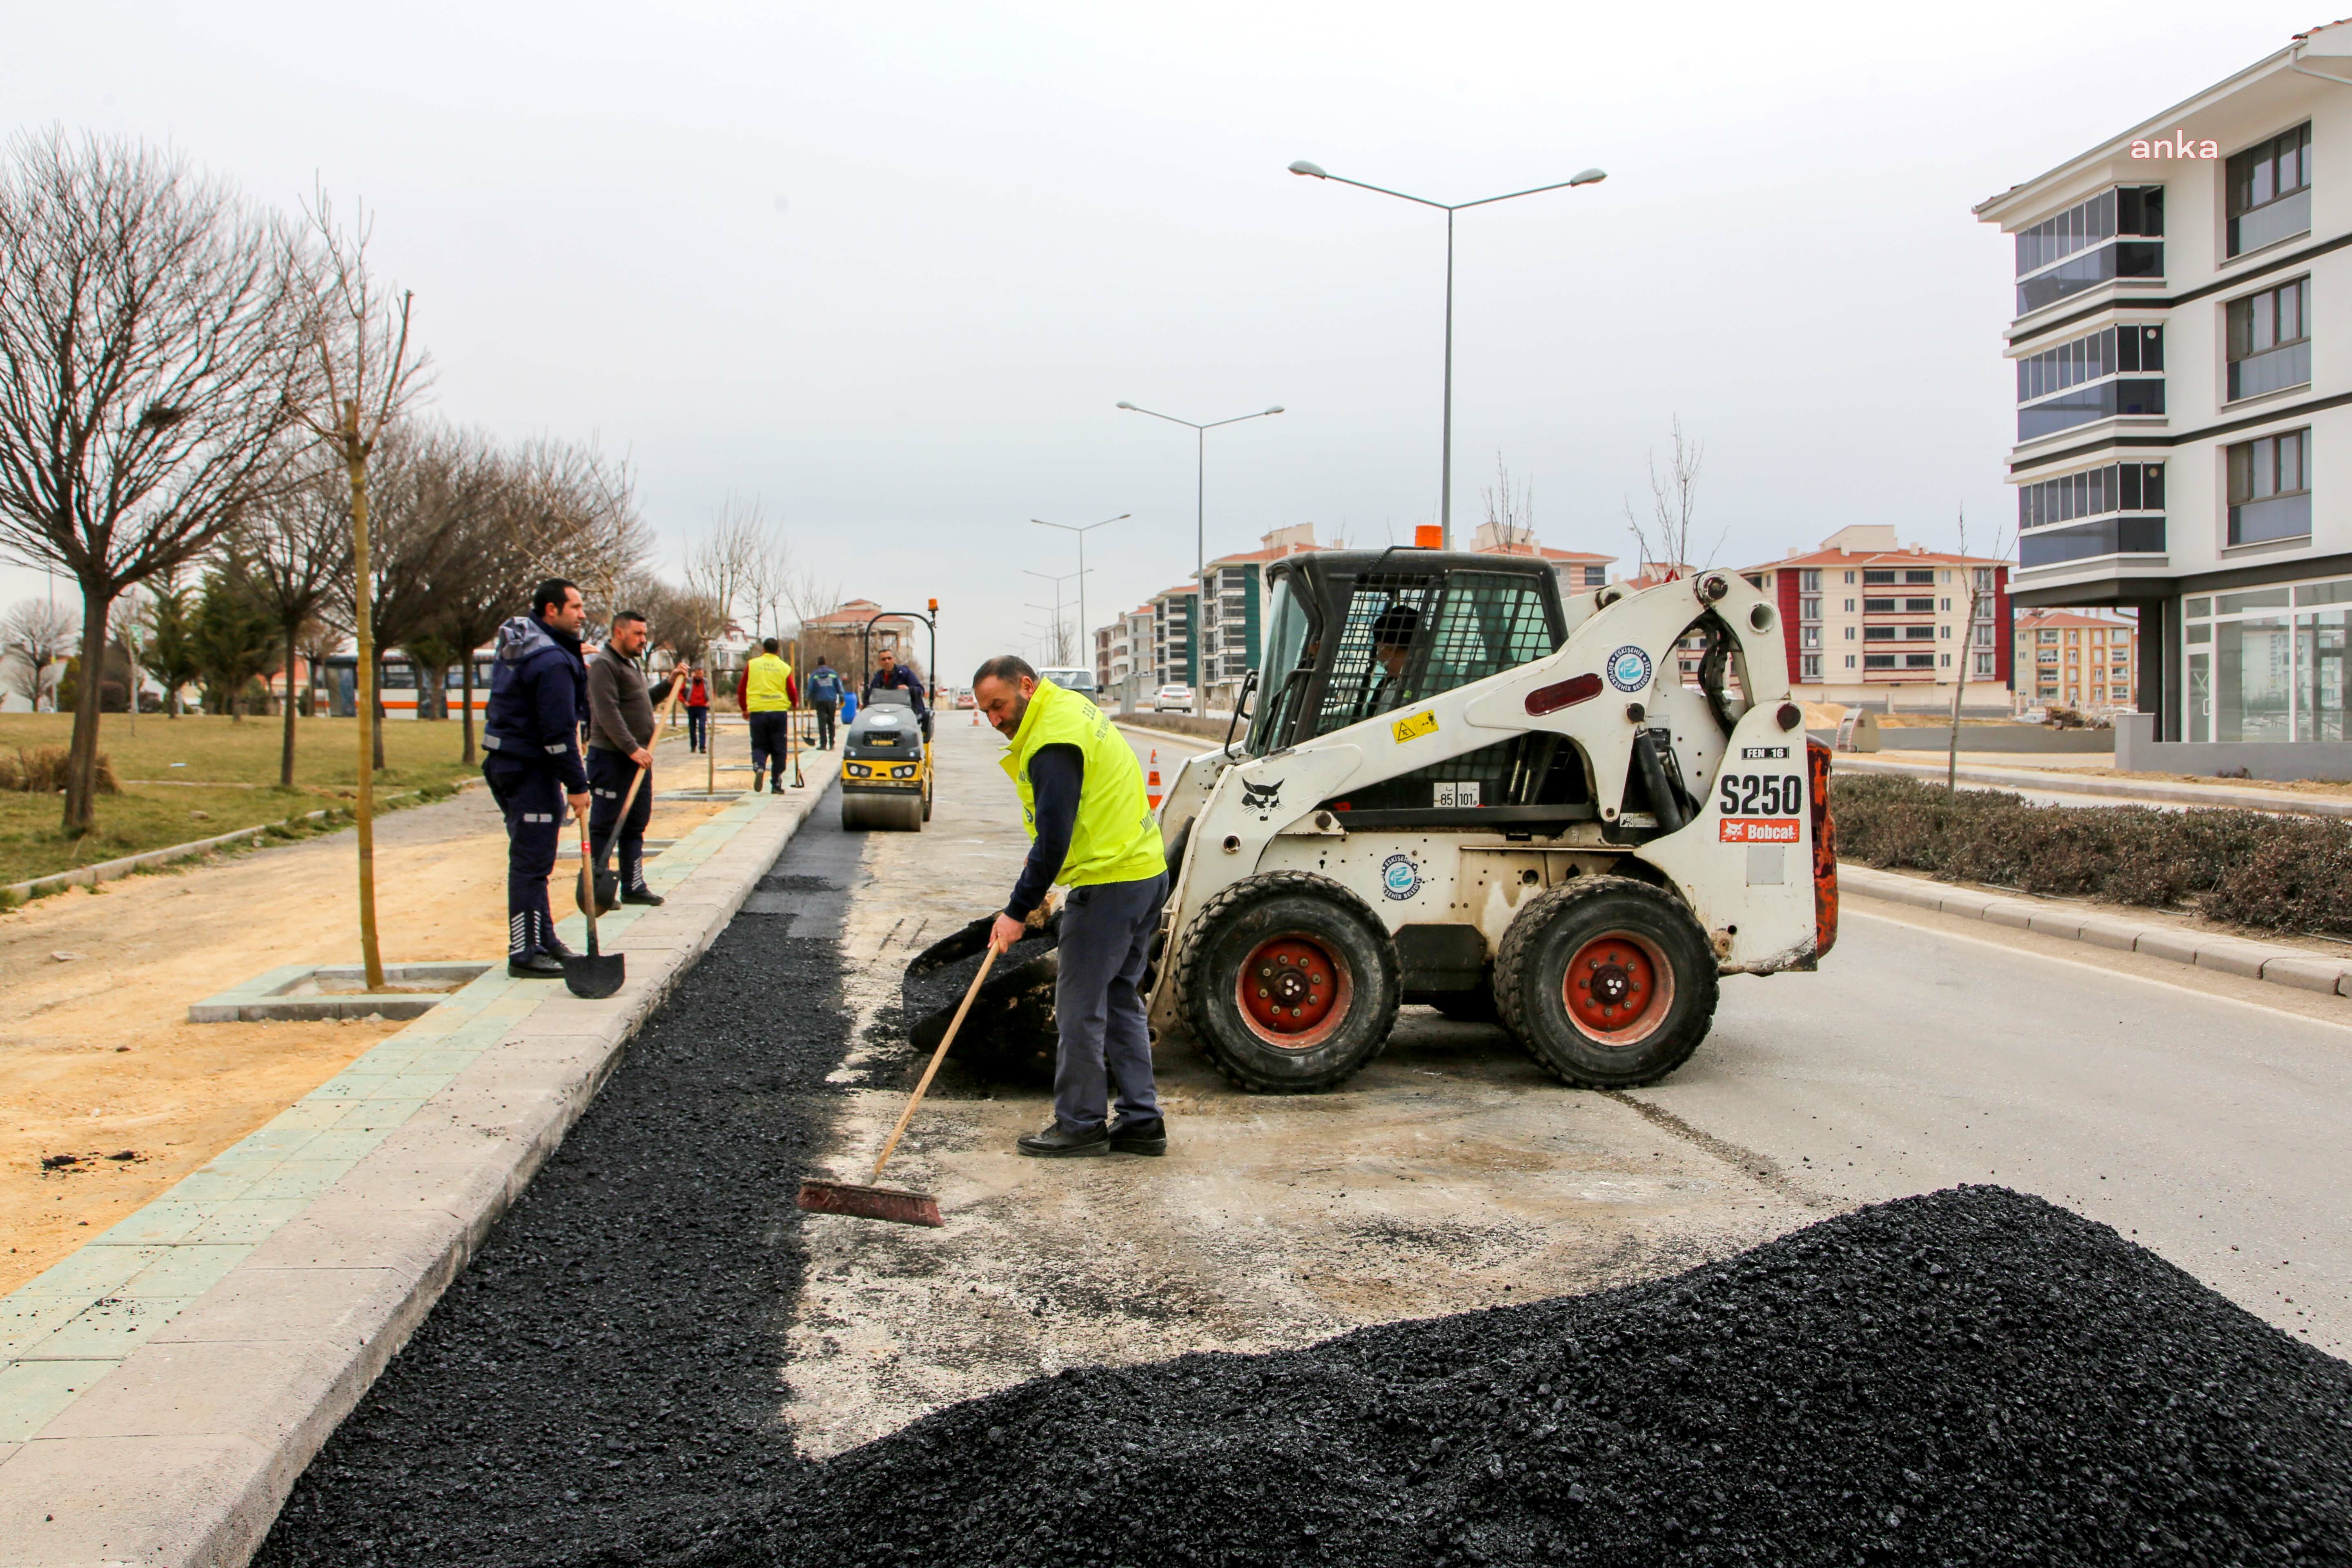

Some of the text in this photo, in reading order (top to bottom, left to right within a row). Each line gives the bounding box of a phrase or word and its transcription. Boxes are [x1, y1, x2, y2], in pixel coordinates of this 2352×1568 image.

[1615, 647, 1644, 657] ESKİŞEHİR
[1608, 662, 1650, 691] BÜYÜKŞEHİR BELEDİYESİ
[1747, 748, 1784, 757] FEN 16
[1441, 793, 1453, 806] 85
[1459, 793, 1472, 805] 101
[1720, 775, 1802, 815] S250
[1748, 824, 1794, 840] Bobcat
